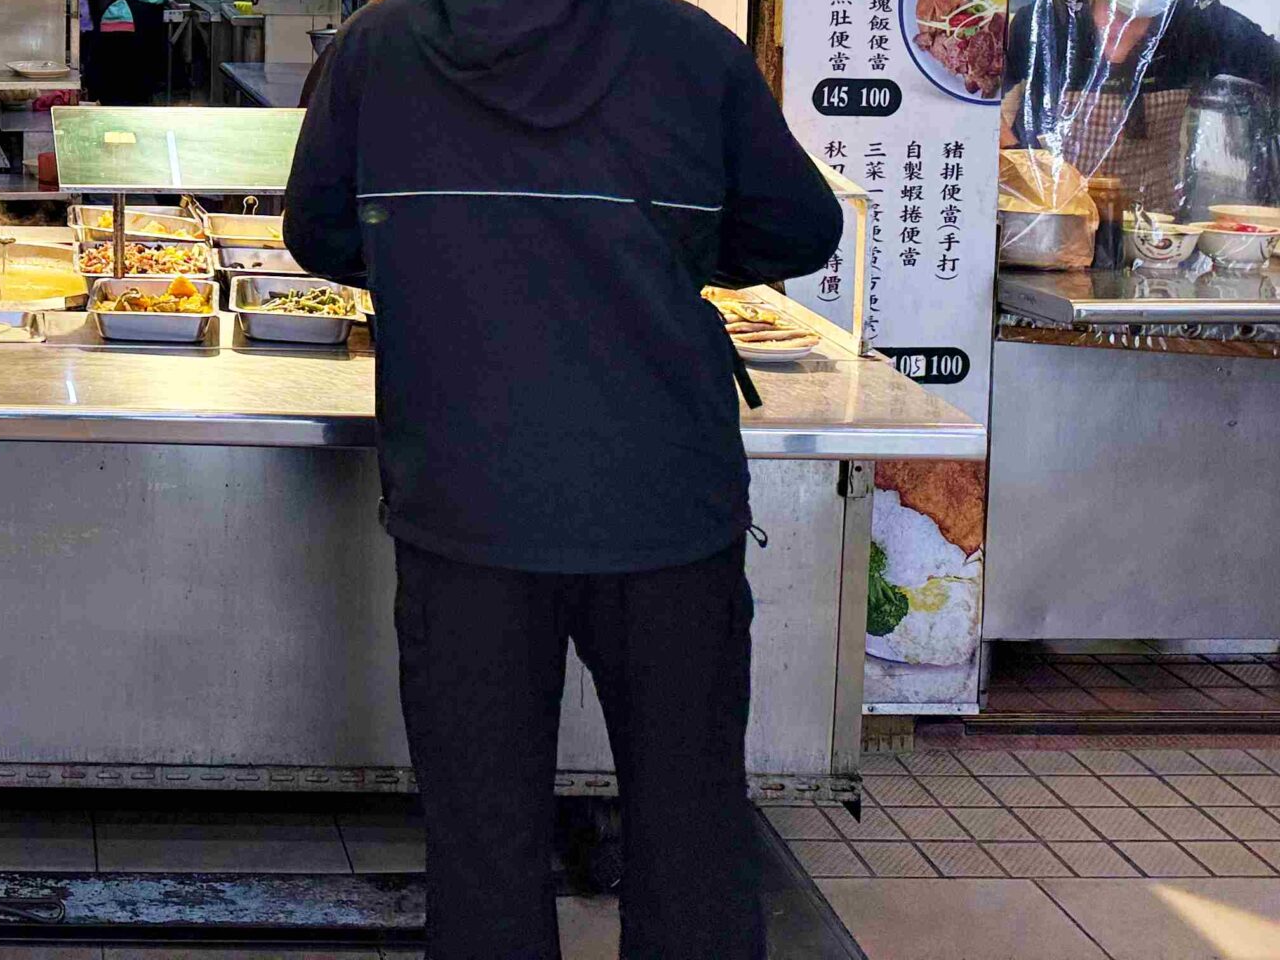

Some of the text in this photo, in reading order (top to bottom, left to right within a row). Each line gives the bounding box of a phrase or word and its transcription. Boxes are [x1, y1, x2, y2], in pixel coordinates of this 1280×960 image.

[822, 86, 890, 107] 145 100
[899, 140, 924, 267] 自製蝦捲便當
[931, 355, 963, 376] 100
